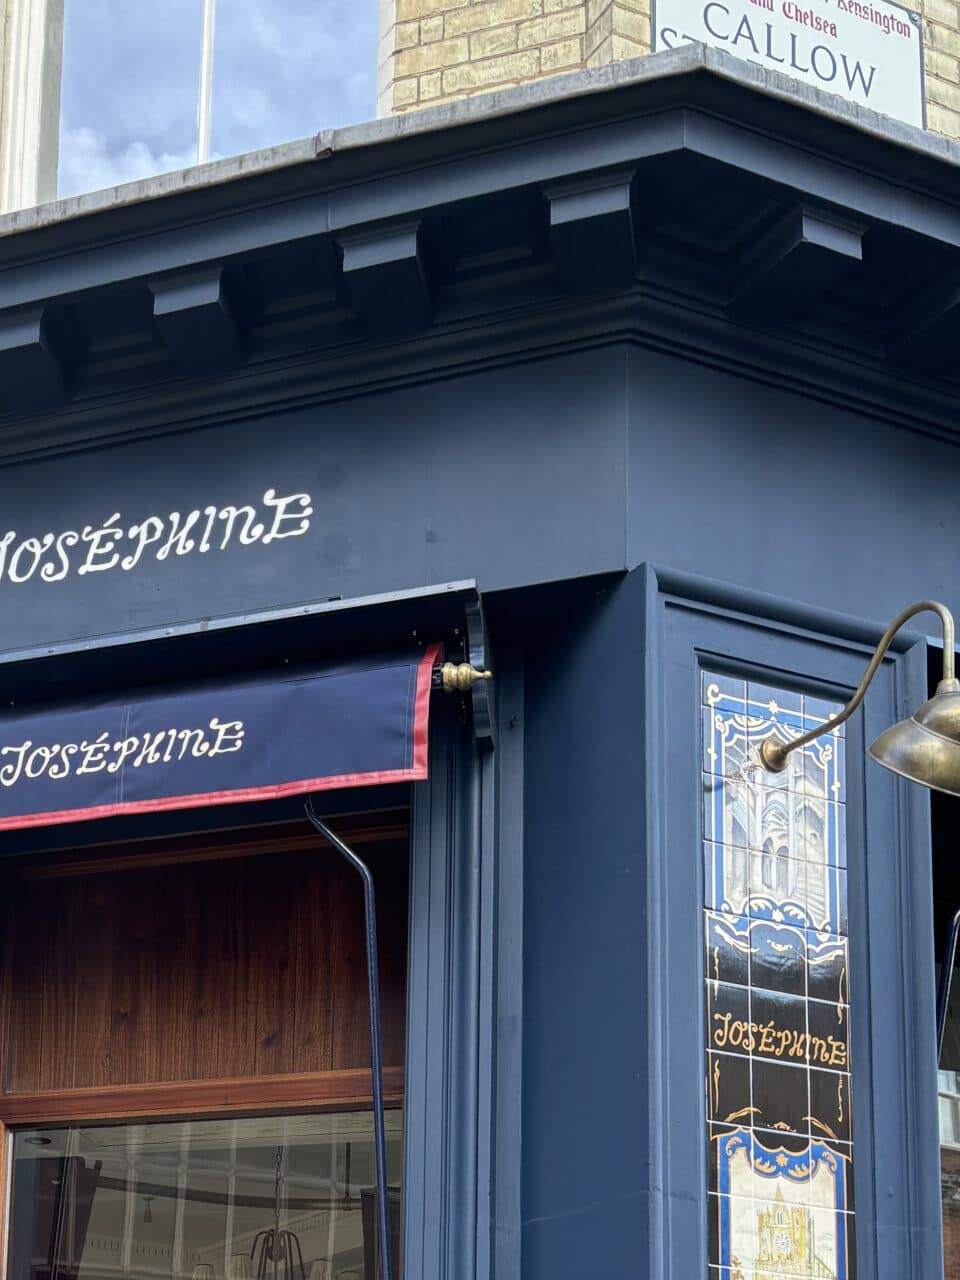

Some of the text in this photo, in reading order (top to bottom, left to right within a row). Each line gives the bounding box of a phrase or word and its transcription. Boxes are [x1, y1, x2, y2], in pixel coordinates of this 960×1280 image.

[782, 2, 838, 38] Chelsea
[837, 0, 911, 38] Kensington
[702, 2, 877, 98] CALLOW
[0, 718, 245, 787] JOSÉPHINE
[713, 1012, 847, 1066] JOSÉPHINE
